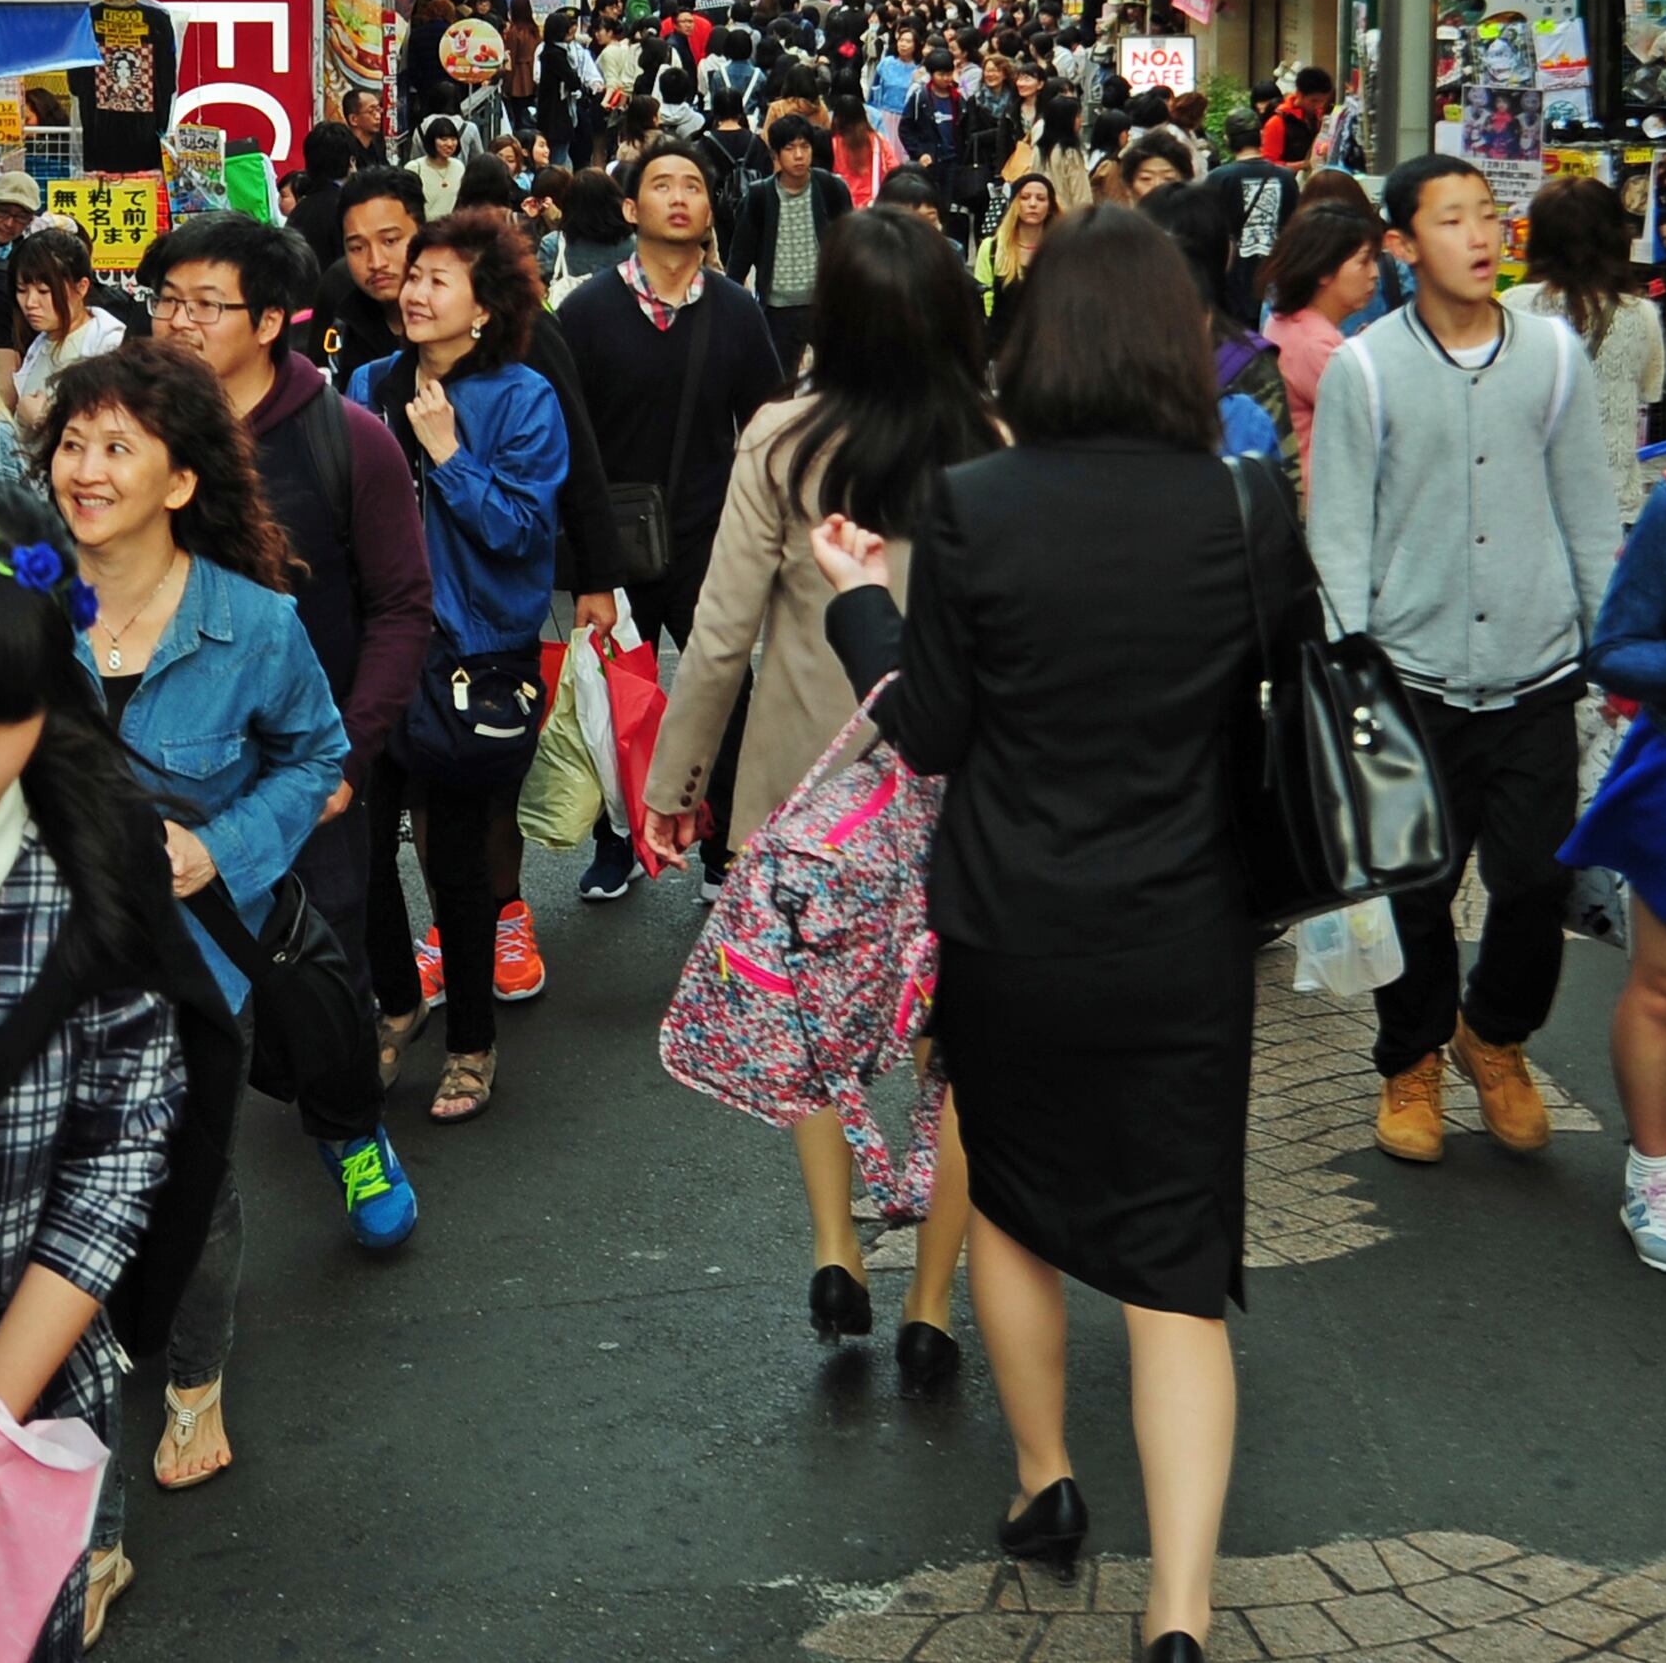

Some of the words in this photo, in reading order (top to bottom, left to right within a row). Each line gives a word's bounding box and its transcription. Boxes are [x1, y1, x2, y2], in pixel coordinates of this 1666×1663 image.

[1132, 48, 1184, 67] NOA
[1130, 69, 1185, 85] CAFE
[53, 189, 148, 208] 無料で
